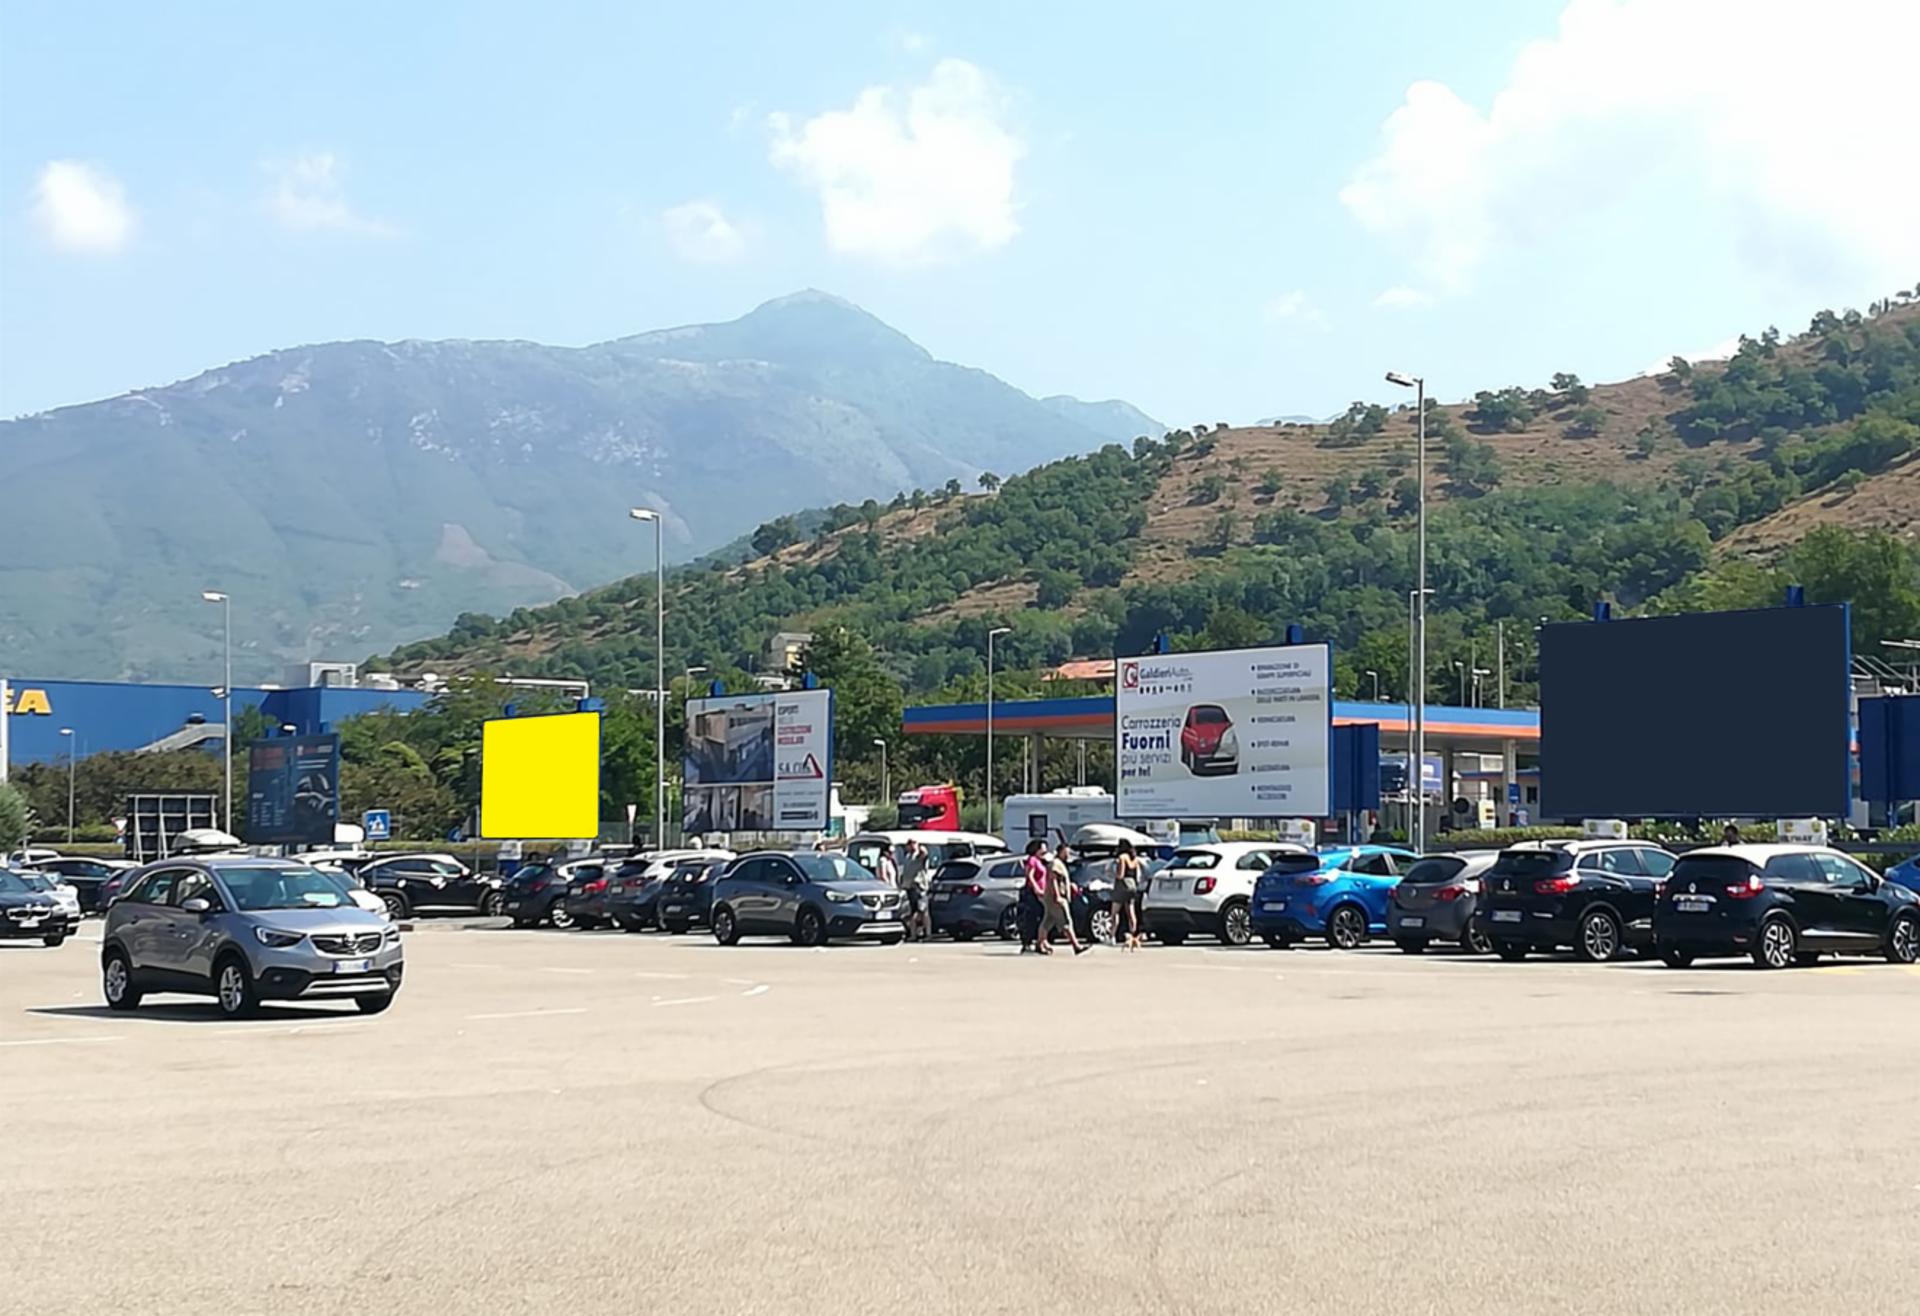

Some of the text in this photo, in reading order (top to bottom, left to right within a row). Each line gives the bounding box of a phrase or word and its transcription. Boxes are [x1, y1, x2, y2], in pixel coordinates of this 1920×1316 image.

[1121, 713, 1181, 730] Carrozzeria
[1122, 729, 1171, 750] Fuorni
[1140, 752, 1172, 765] servizi
[1121, 768, 1136, 780] per
